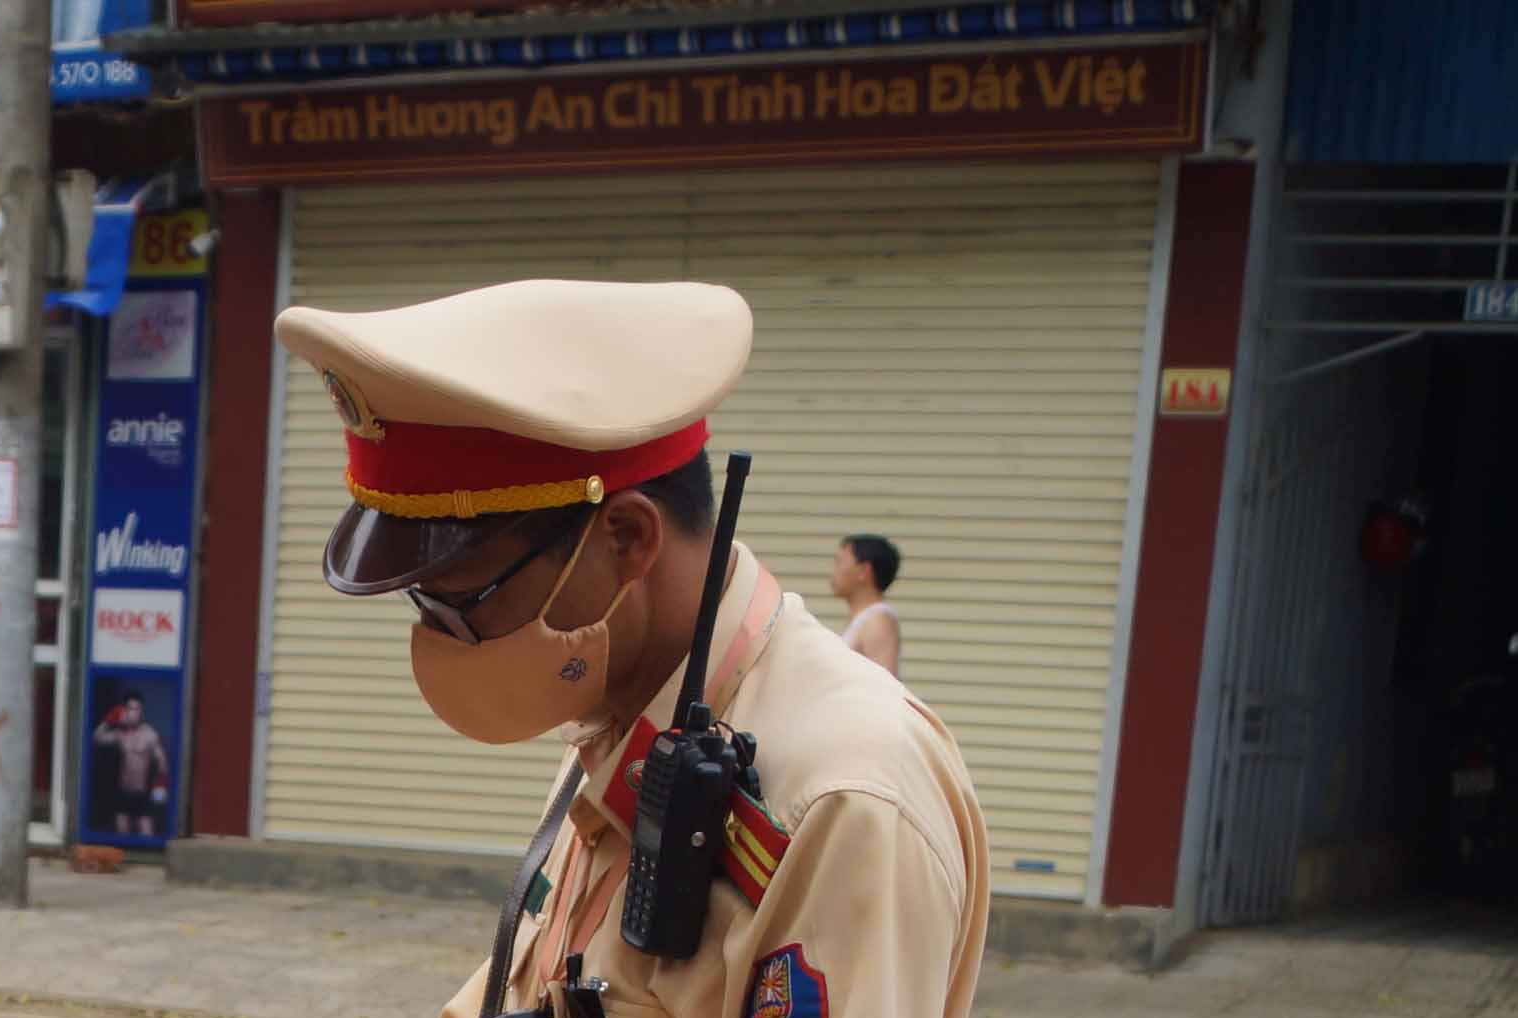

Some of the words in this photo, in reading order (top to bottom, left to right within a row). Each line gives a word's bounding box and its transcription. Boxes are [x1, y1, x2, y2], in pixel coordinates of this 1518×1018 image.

[524, 85, 594, 131] An
[813, 67, 919, 121] Hoa
[1032, 55, 1148, 116] Việt
[106, 411, 186, 444] annie
